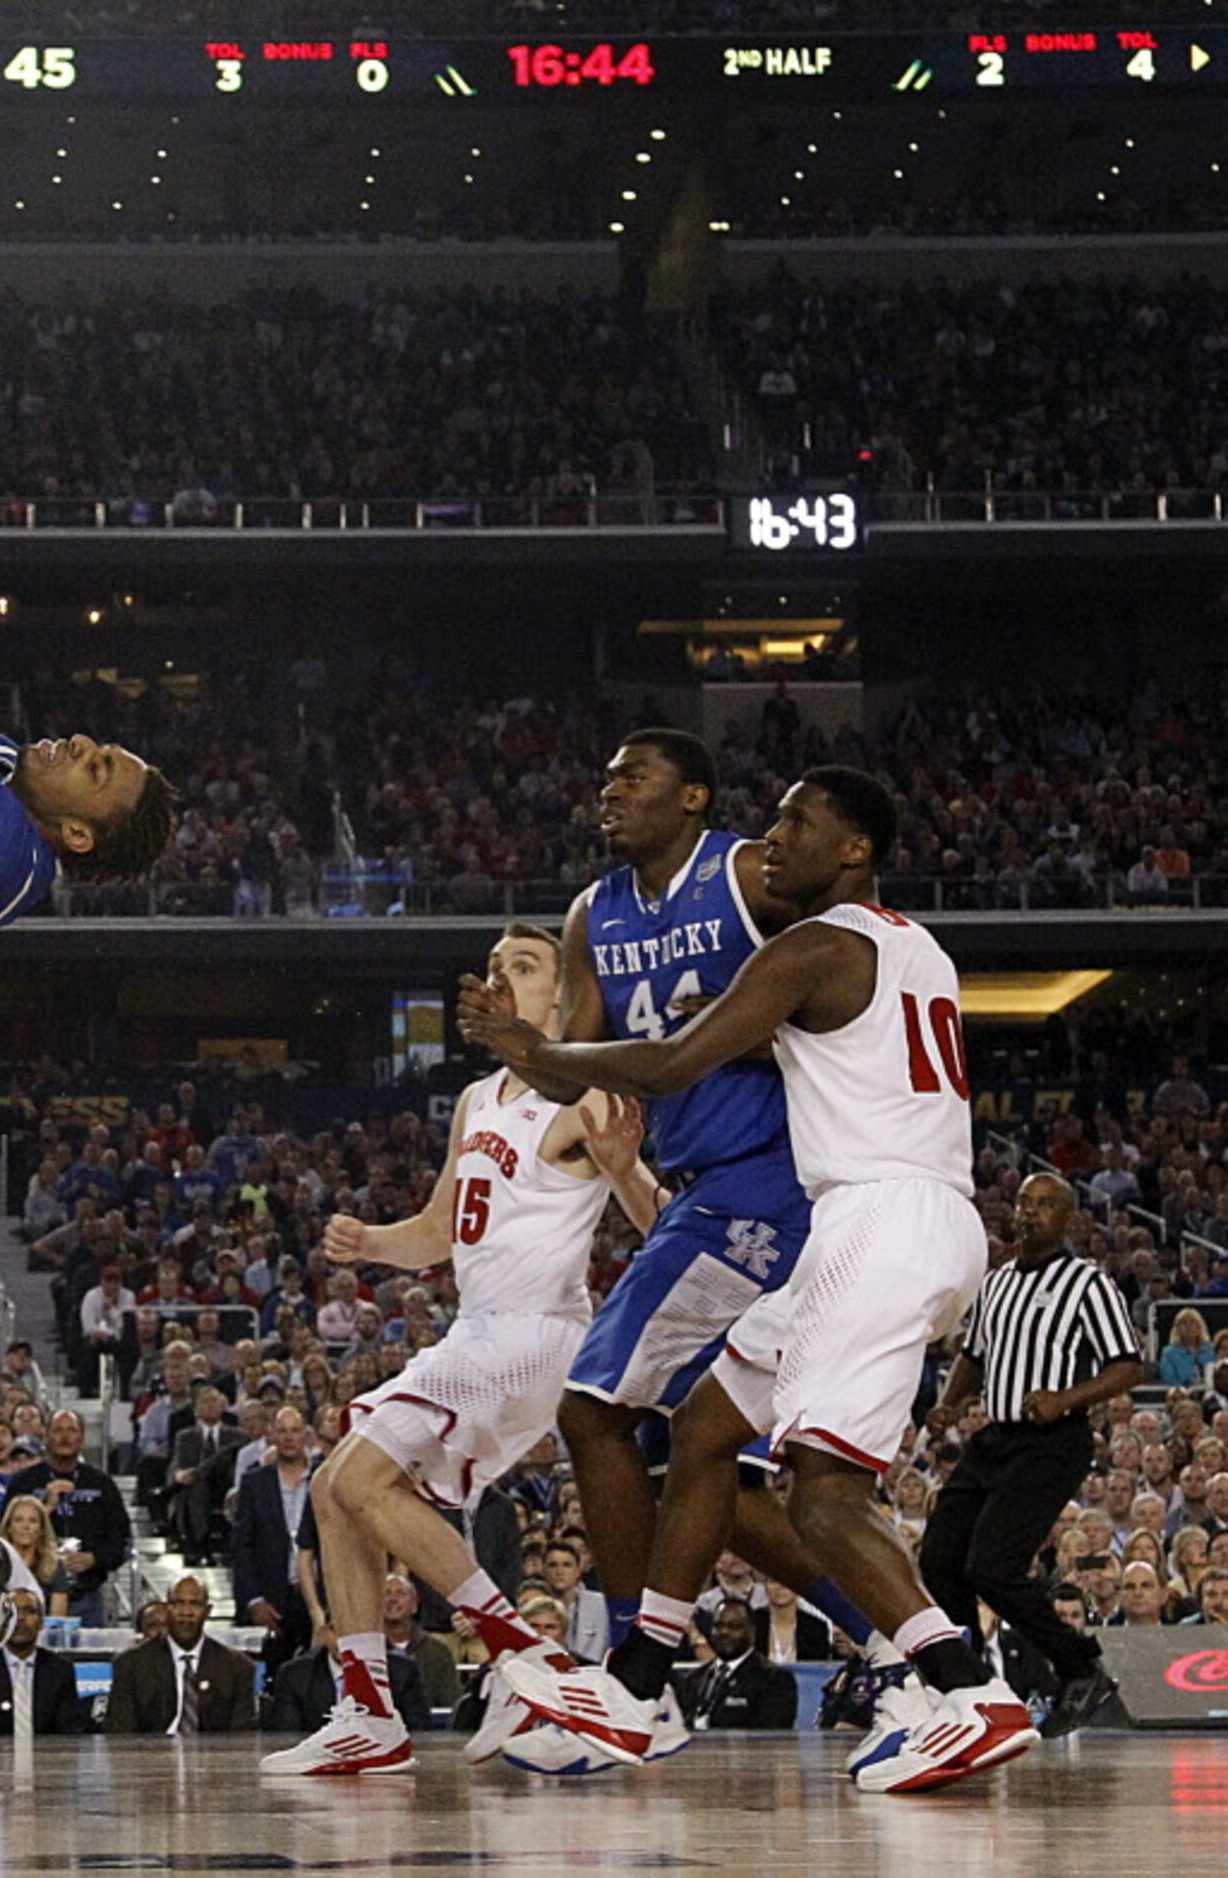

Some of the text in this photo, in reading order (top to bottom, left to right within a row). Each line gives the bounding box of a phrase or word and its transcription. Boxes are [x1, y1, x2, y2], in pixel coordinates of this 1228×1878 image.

[206, 42, 388, 60] TOL BONUS FLS
[968, 31, 1158, 52] FLS BONUS TOL
[4, 47, 76, 88] 45
[216, 60, 242, 92] 3
[357, 60, 389, 92] 0
[507, 43, 655, 86] 16:44
[724, 48, 831, 75] 2ND HALF
[976, 52, 1005, 86] 2
[1126, 48, 1156, 82] 4
[749, 493, 856, 549] 16:43
[900, 990, 970, 1101] 10
[451, 1178, 491, 1246] 15
